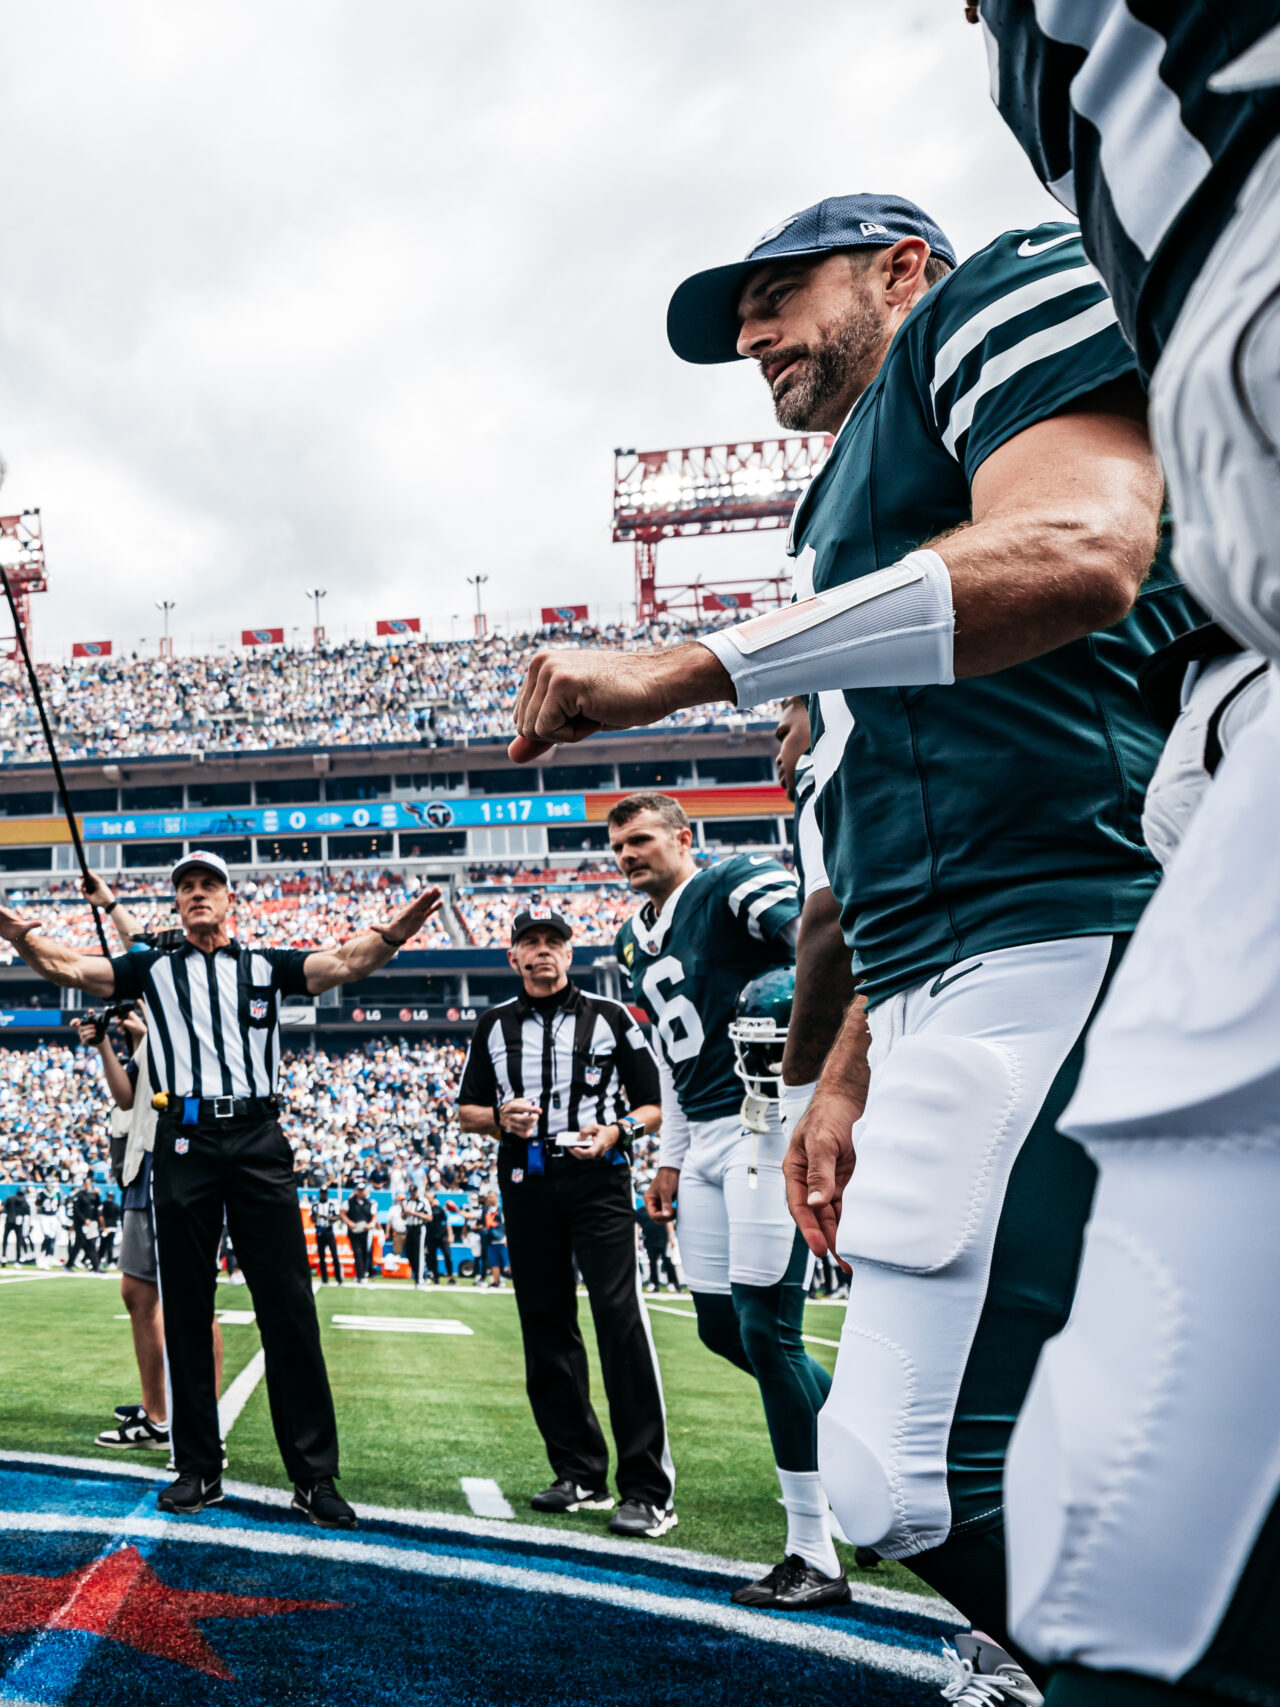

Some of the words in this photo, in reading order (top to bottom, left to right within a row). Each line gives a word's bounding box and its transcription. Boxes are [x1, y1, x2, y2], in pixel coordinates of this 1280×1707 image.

[352, 808, 370, 827] 0
[480, 800, 533, 822] 1:17
[545, 801, 572, 817] 1st
[102, 821, 122, 835] 1st
[288, 811, 307, 829] 0
[366, 1010, 381, 1021] LG
[413, 1009, 428, 1021] LG
[460, 1008, 477, 1020] LG
[641, 955, 706, 1064] 6
